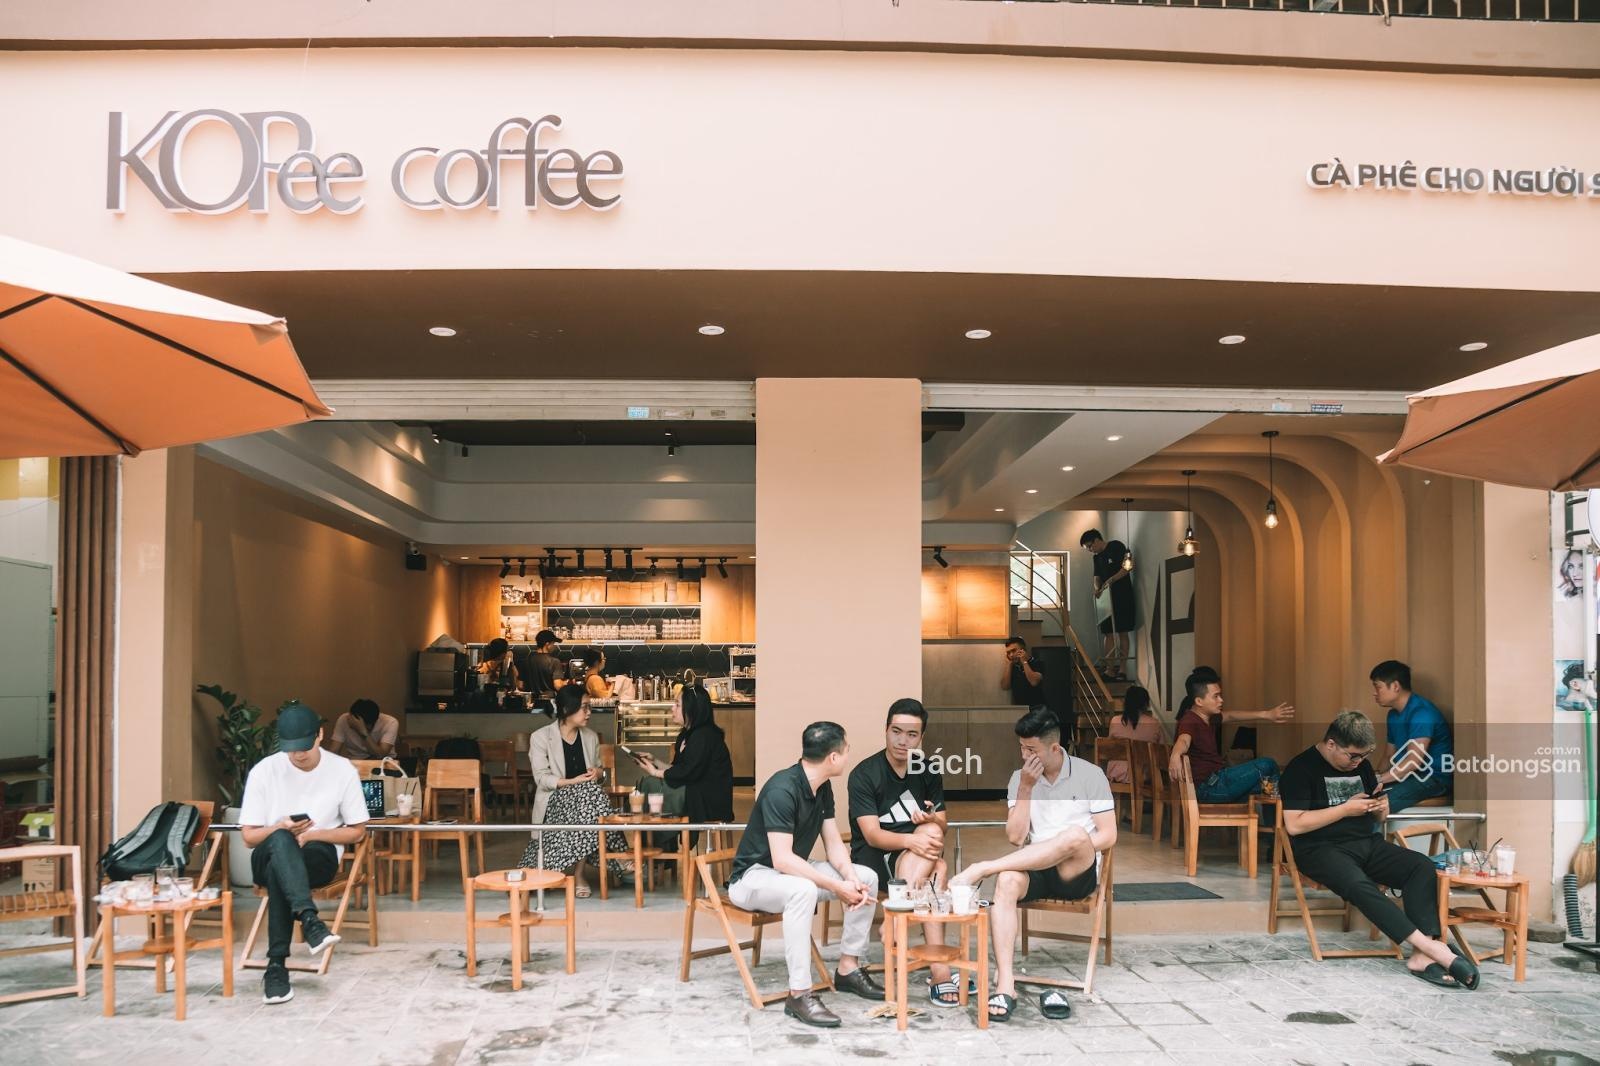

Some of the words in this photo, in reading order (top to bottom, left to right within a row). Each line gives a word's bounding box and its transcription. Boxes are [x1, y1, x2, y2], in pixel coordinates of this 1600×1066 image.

[391, 114, 623, 210] coffee
[1309, 157, 1350, 187] CÀ
[1357, 160, 1417, 188] PHÊ
[1424, 166, 1485, 191] CHO
[1492, 165, 1584, 194] NGƯỜI
